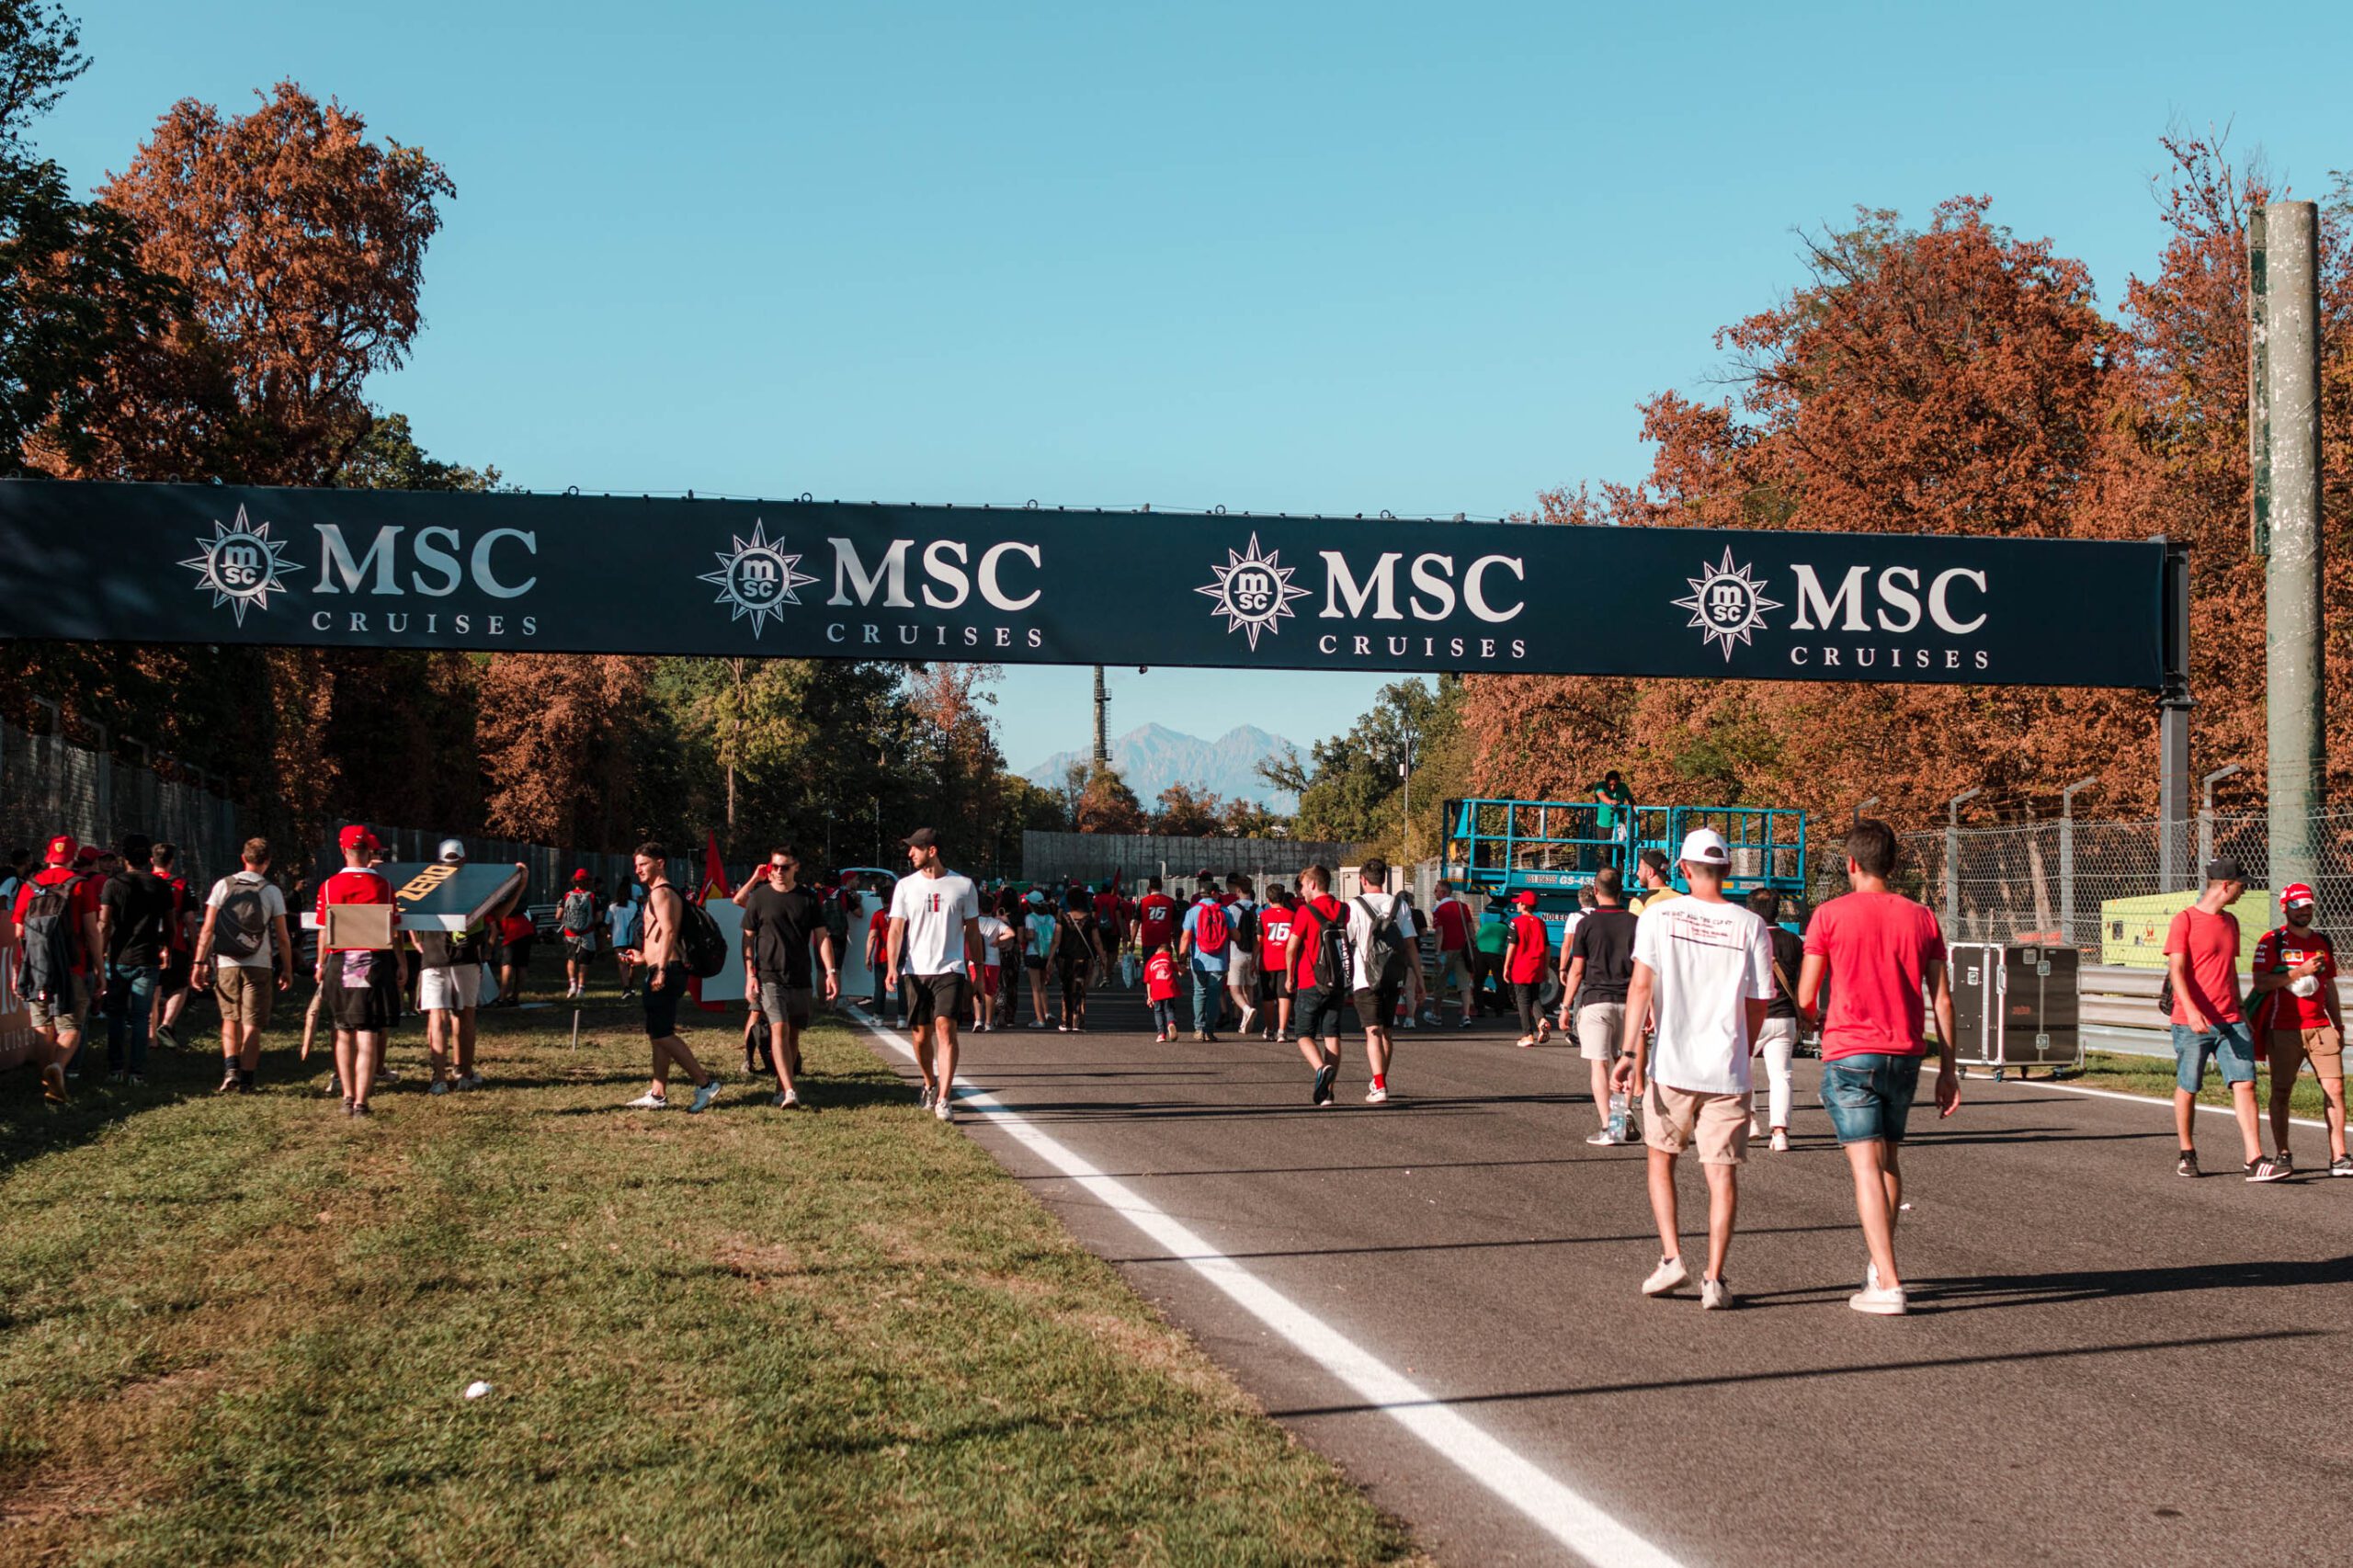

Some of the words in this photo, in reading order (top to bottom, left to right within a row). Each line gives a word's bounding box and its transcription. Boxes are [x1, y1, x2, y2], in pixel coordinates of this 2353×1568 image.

[313, 524, 536, 598] MSC
[827, 538, 1040, 611] MSC
[1319, 551, 1524, 622] MSC
[1790, 563, 1986, 634] MSC
[313, 611, 536, 635] CRUISES
[827, 623, 1040, 647] CRUISES
[1319, 635, 1525, 658] CRUISES
[1790, 646, 1987, 669] CRUISES
[1267, 922, 1291, 941] 16
